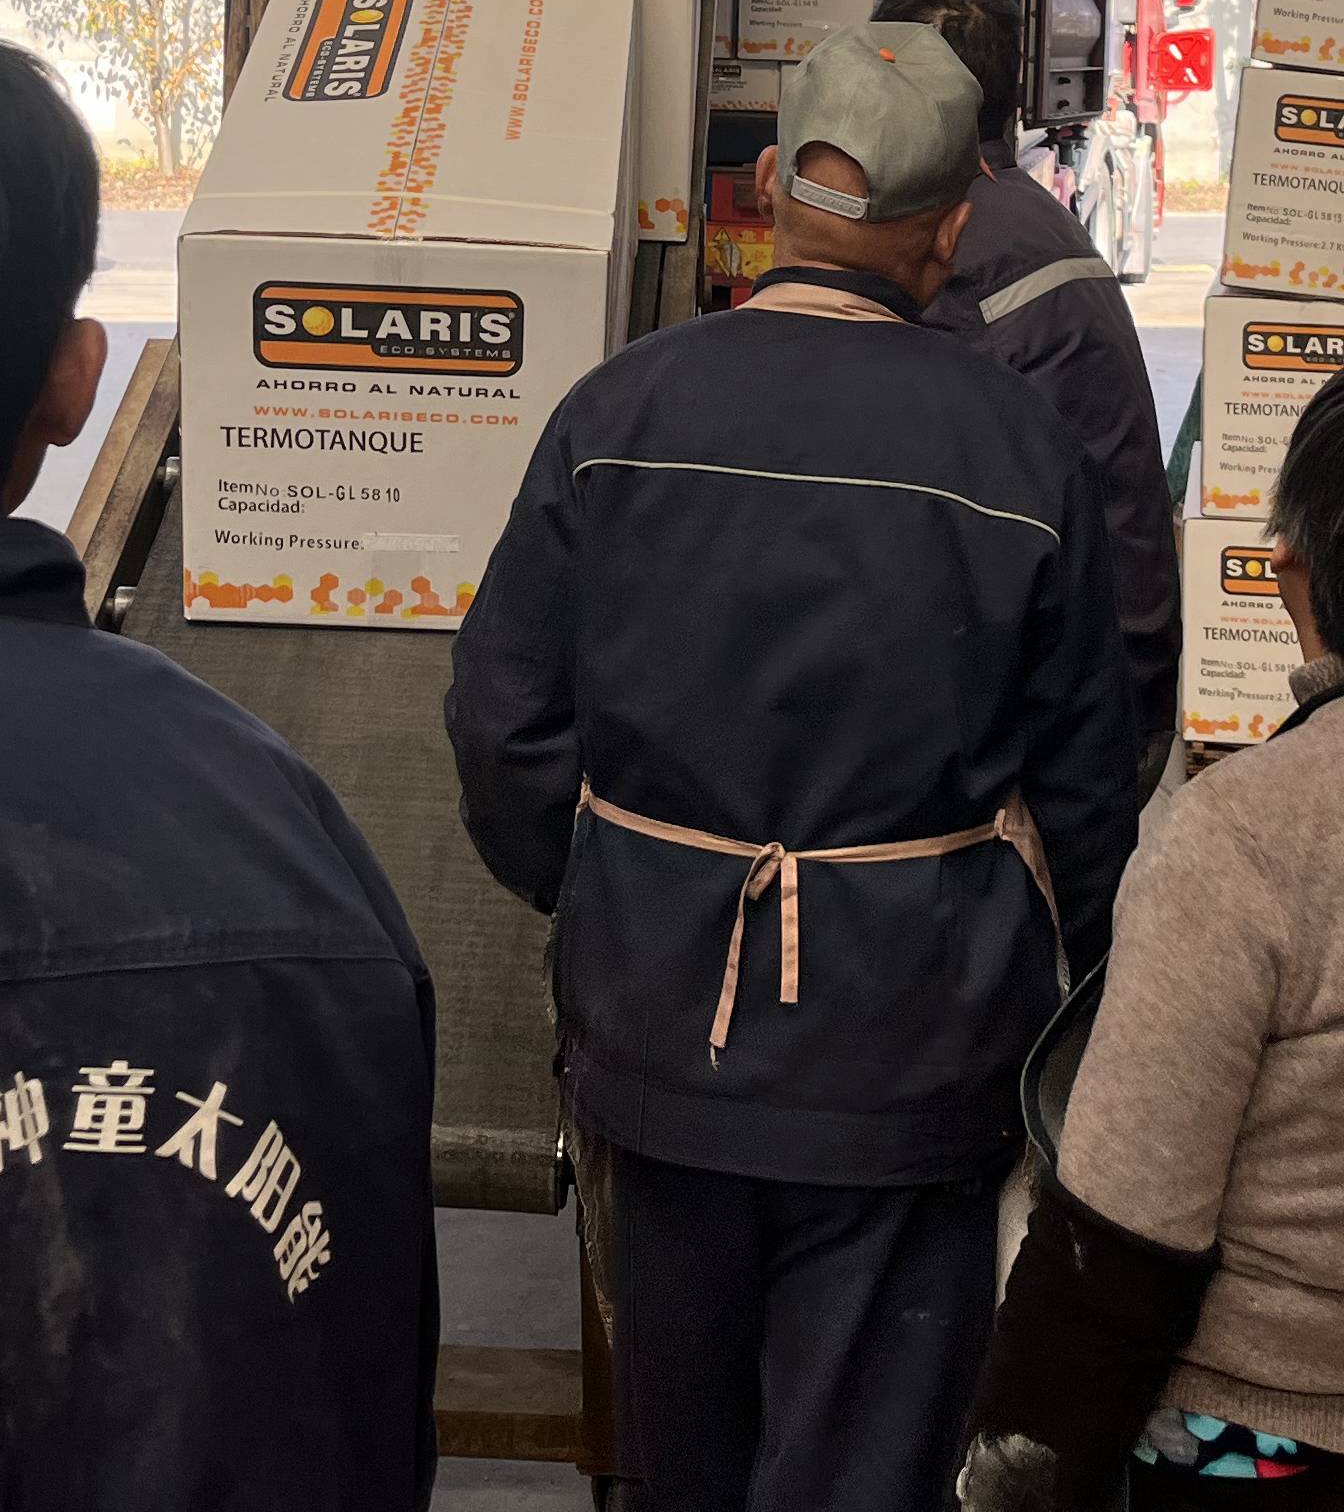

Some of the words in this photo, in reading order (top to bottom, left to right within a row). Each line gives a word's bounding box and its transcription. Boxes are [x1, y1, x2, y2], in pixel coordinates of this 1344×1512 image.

[1274, 8, 1309, 22] Working
[283, 37, 297, 49] AL
[265, 53, 292, 102] NATURAL
[1273, 148, 1325, 158] AHORRO
[1242, 232, 1278, 246] Working
[264, 305, 511, 344] SOLARIS
[1243, 376, 1294, 384] AHORRO
[256, 379, 356, 392] AHORRO
[369, 384, 397, 394] AL
[410, 386, 520, 399] NATURAL
[220, 426, 423, 454] TERMOTANQUE
[1220, 462, 1255, 475] Working
[218, 497, 304, 514] Capacidad:
[215, 530, 284, 550] Working
[1222, 600, 1273, 609] AHORRO
[1199, 688, 1235, 700] Working
